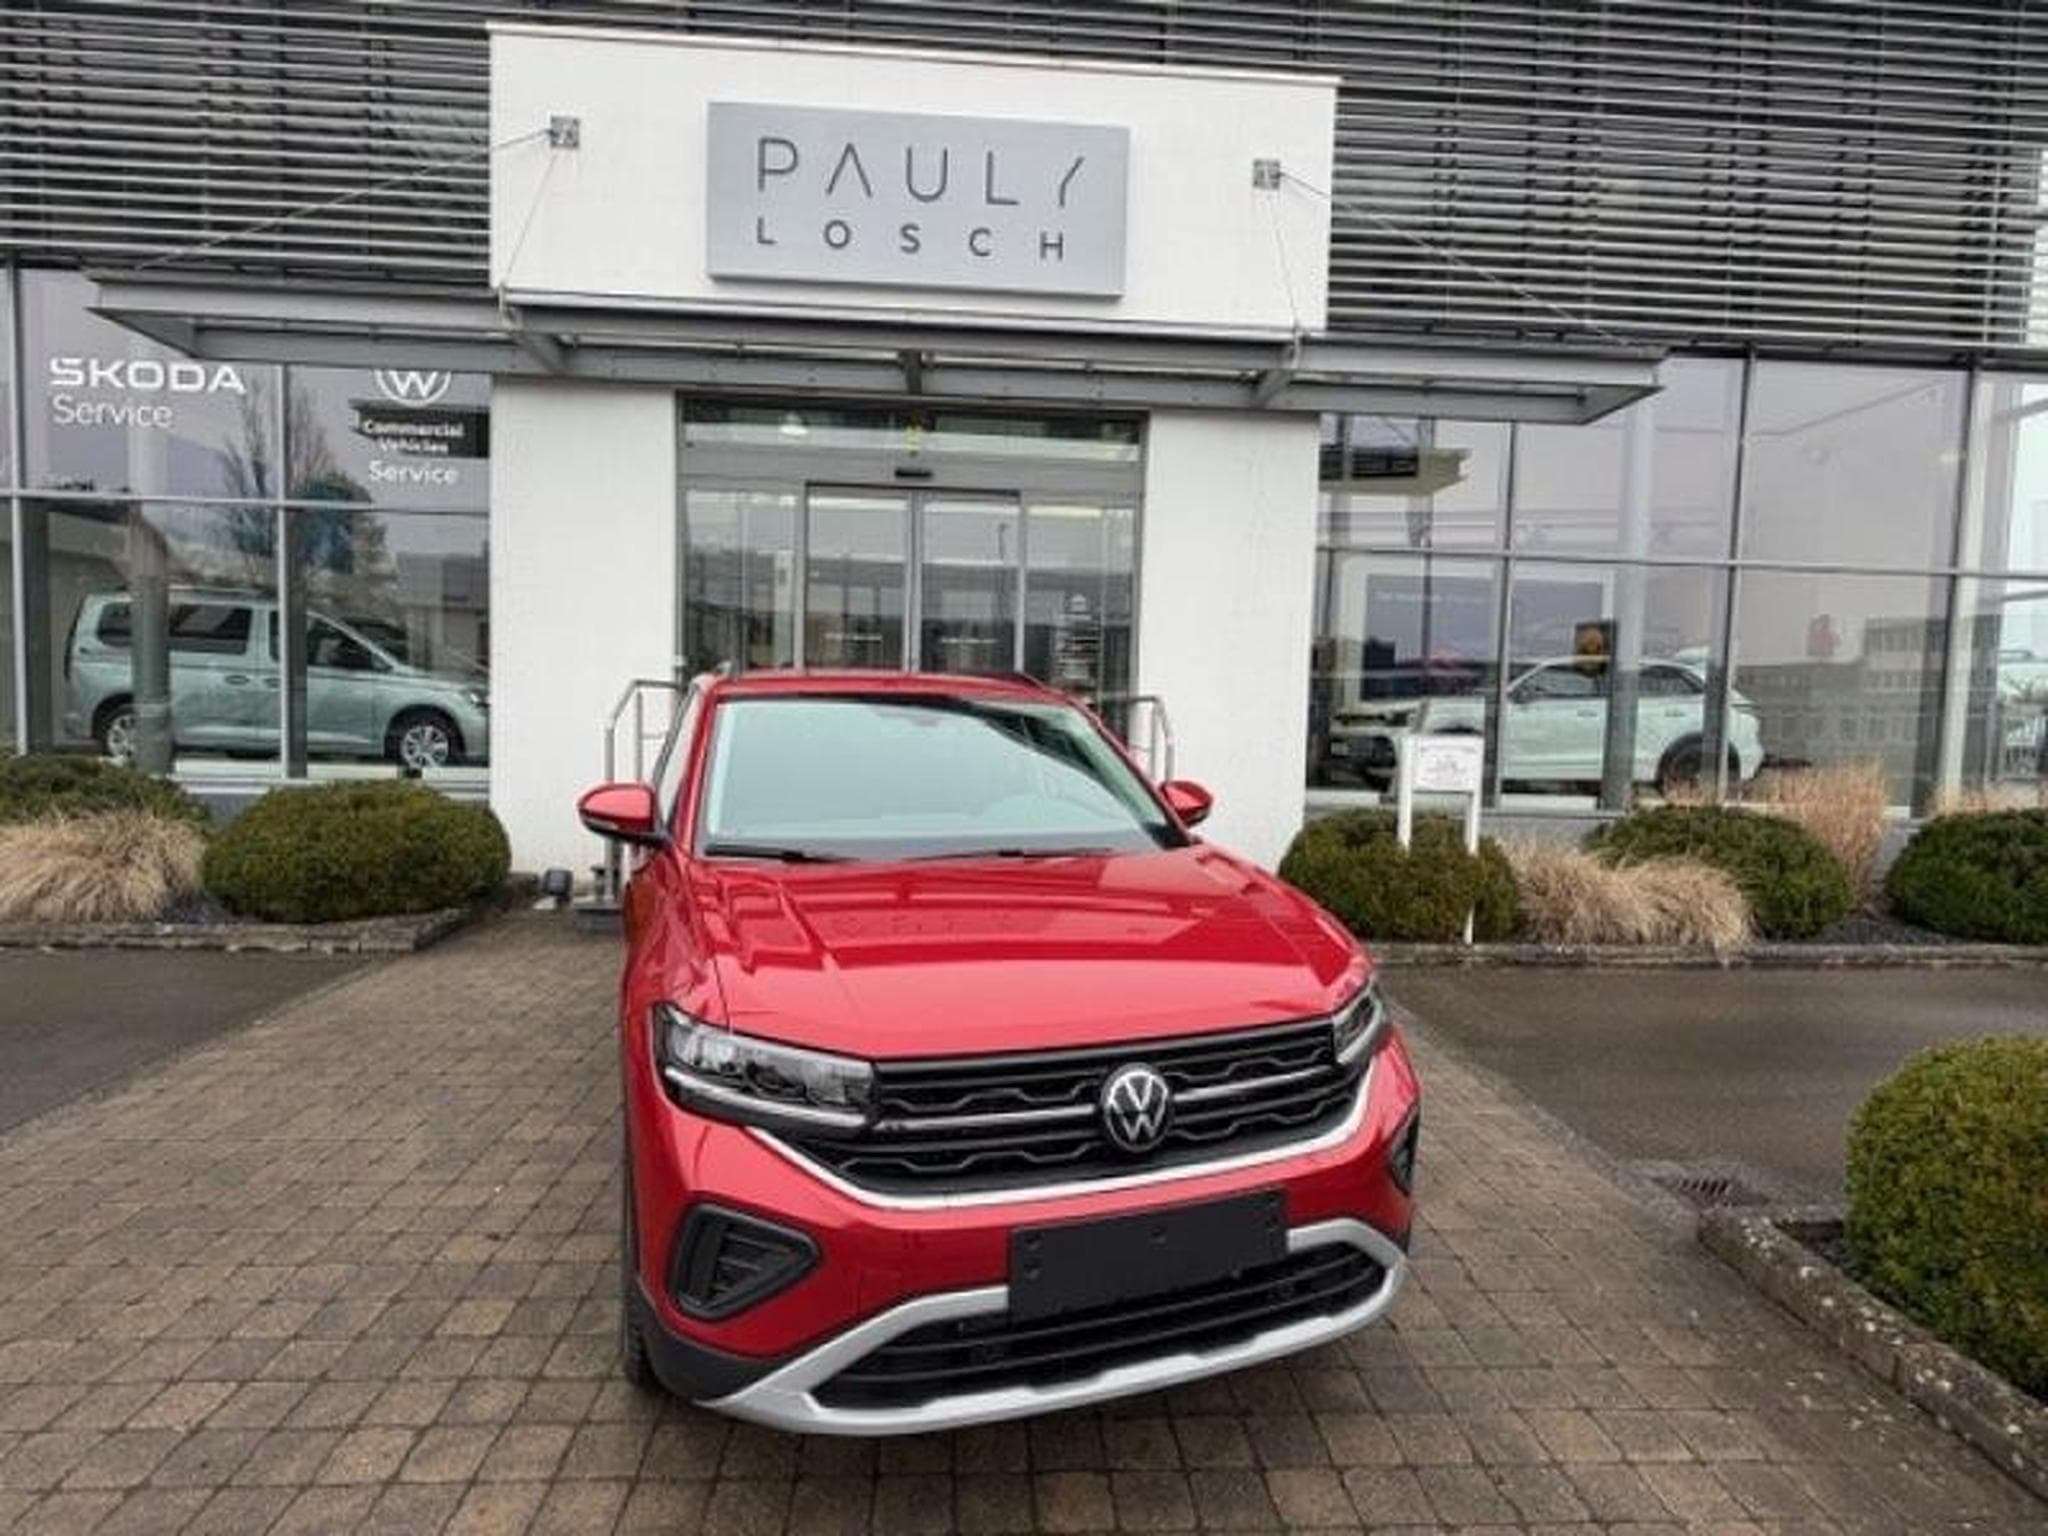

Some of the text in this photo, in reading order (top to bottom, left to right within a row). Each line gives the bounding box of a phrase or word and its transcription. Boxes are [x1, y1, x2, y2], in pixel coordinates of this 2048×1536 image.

[757, 136, 1085, 208] PAULY
[756, 216, 1064, 262] LOSCH
[53, 393, 173, 428] Service
[363, 420, 464, 437] Commercial
[368, 460, 459, 484] Service
